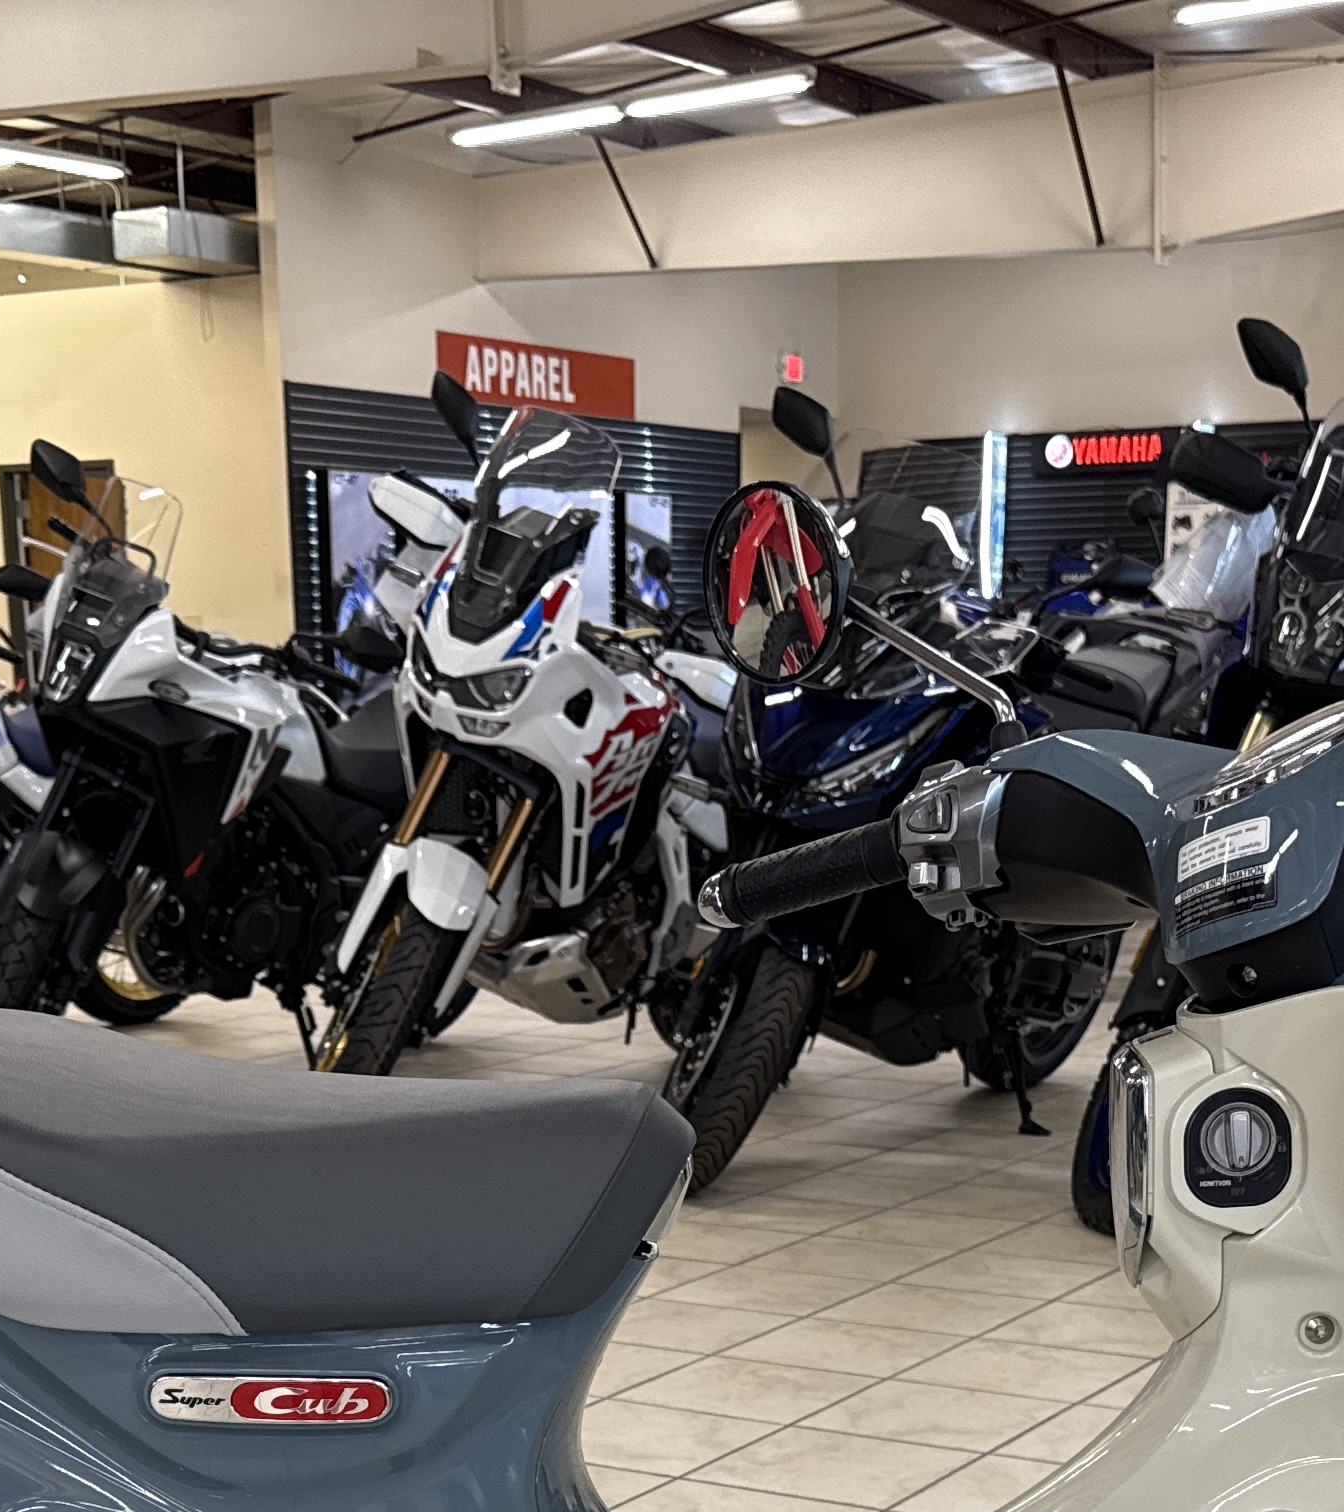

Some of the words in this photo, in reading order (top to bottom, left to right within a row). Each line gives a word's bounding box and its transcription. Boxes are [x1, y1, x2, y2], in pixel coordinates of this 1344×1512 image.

[464, 343, 577, 404] APPAREL
[1072, 431, 1163, 466] YAMAHA
[1199, 1179, 1232, 1188] IGNITION
[158, 1388, 227, 1408] Super
[254, 1386, 370, 1417] Cub
